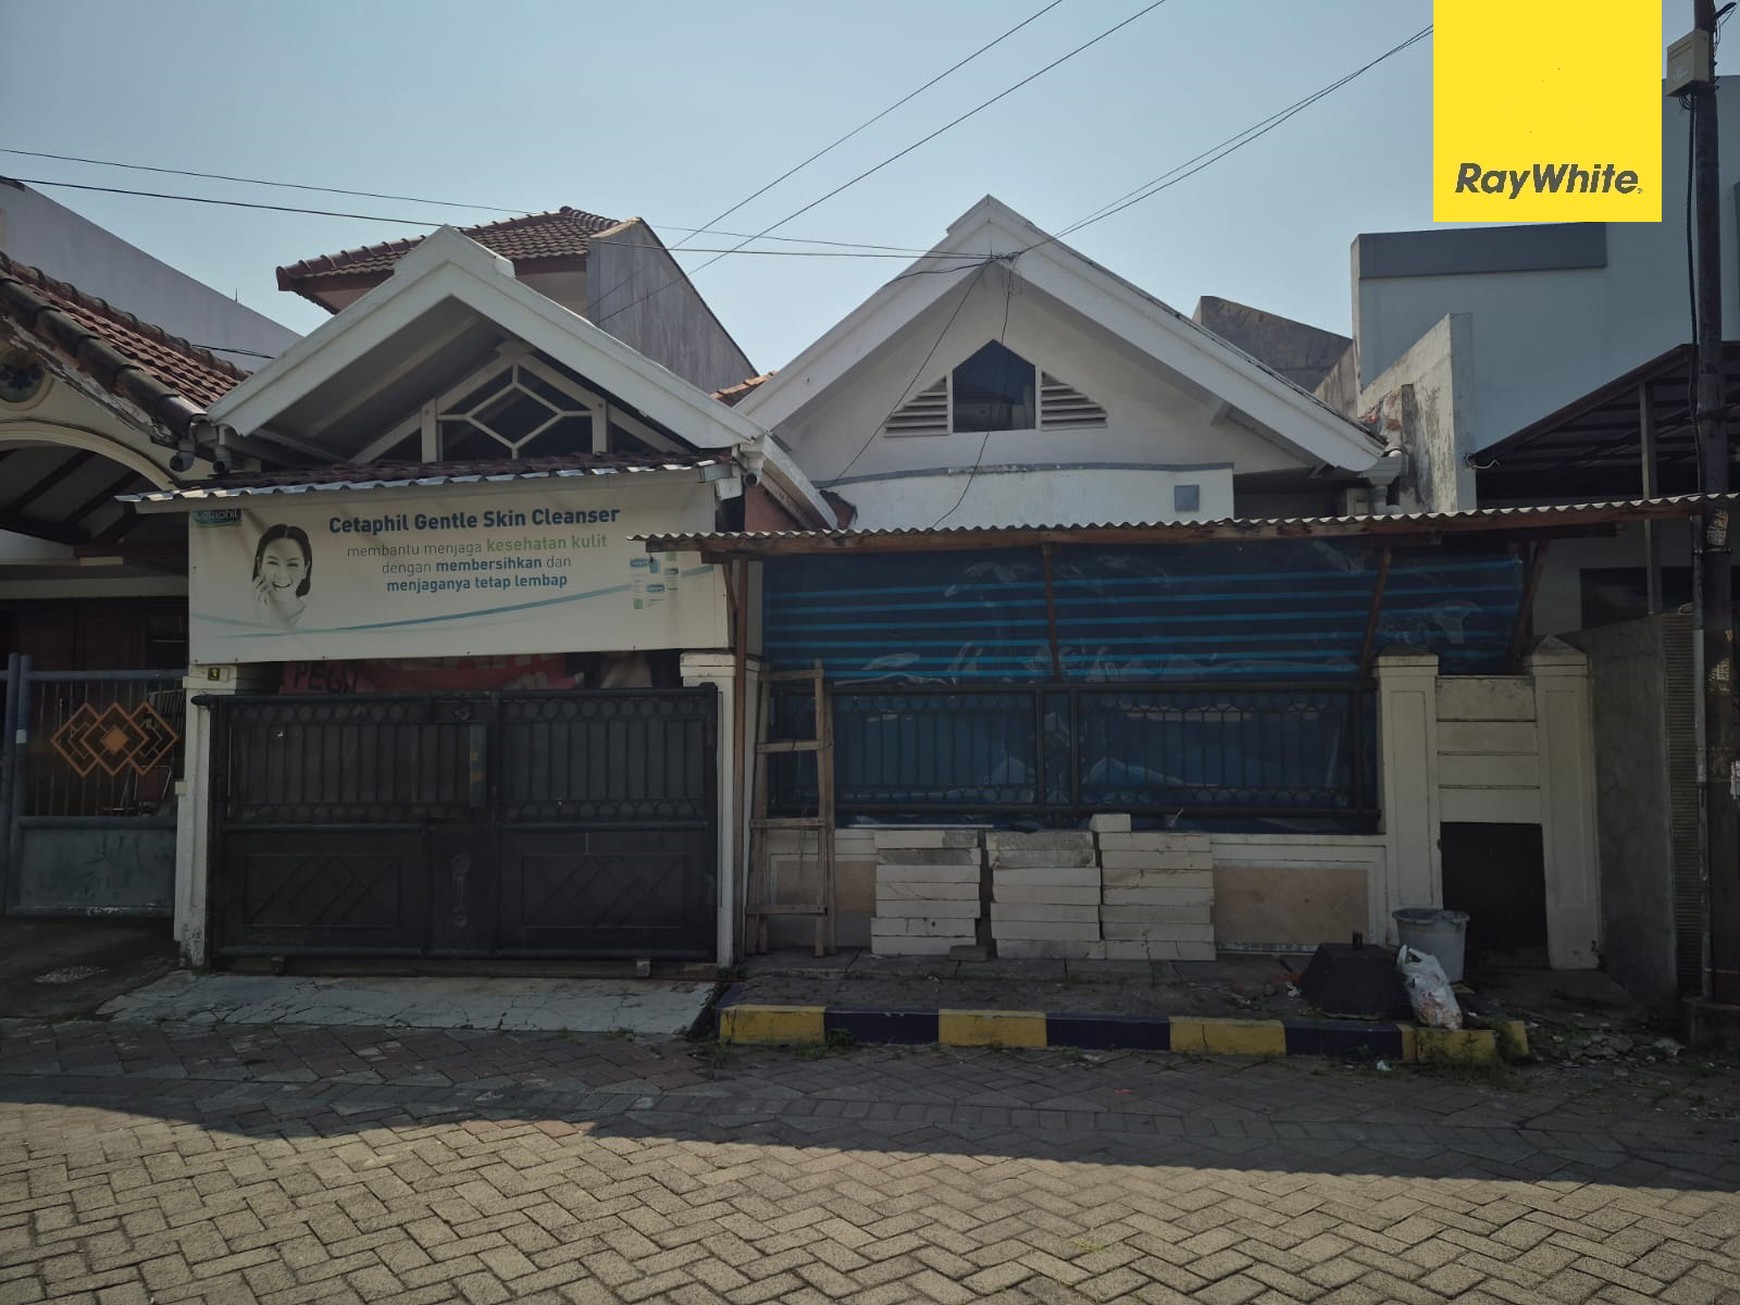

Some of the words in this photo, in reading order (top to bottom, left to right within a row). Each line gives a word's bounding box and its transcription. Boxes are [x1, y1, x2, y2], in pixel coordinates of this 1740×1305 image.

[329, 514, 409, 535] Cetaphil
[414, 512, 478, 530] Gentle
[483, 509, 527, 527] Skin
[531, 508, 620, 525] Cleanser
[347, 544, 420, 557] membantu
[424, 541, 482, 556] menjaga
[486, 536, 567, 552] kesehatan
[571, 533, 608, 548] kulit
[382, 561, 432, 577] dengan
[436, 556, 542, 572] membersihkan
[546, 555, 572, 569] dan
[386, 577, 471, 594] menjaganya
[475, 575, 511, 590] tetap
[515, 573, 568, 589] lembap
